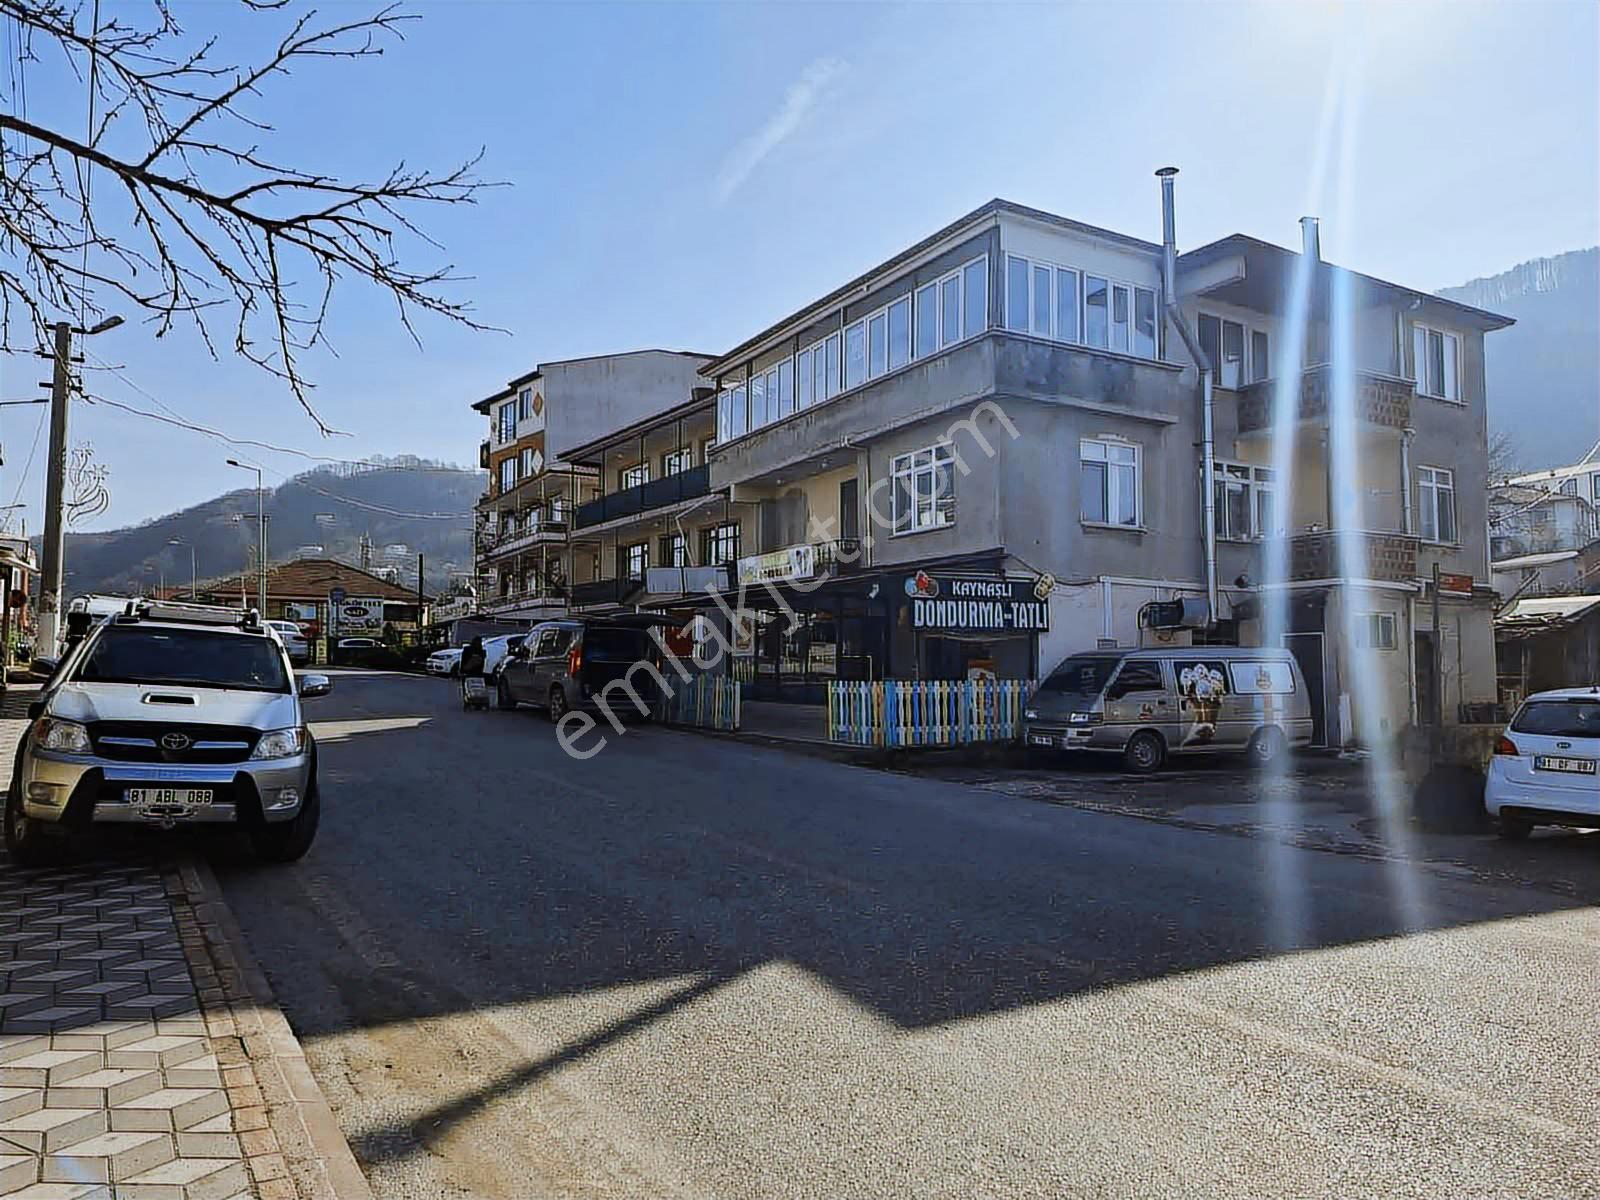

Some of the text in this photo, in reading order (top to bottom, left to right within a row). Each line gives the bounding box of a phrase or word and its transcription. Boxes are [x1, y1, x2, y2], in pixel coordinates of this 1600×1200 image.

[952, 580, 1012, 599] KAYNAŞLI
[131, 789, 146, 803] 81
[156, 789, 178, 803] ABL
